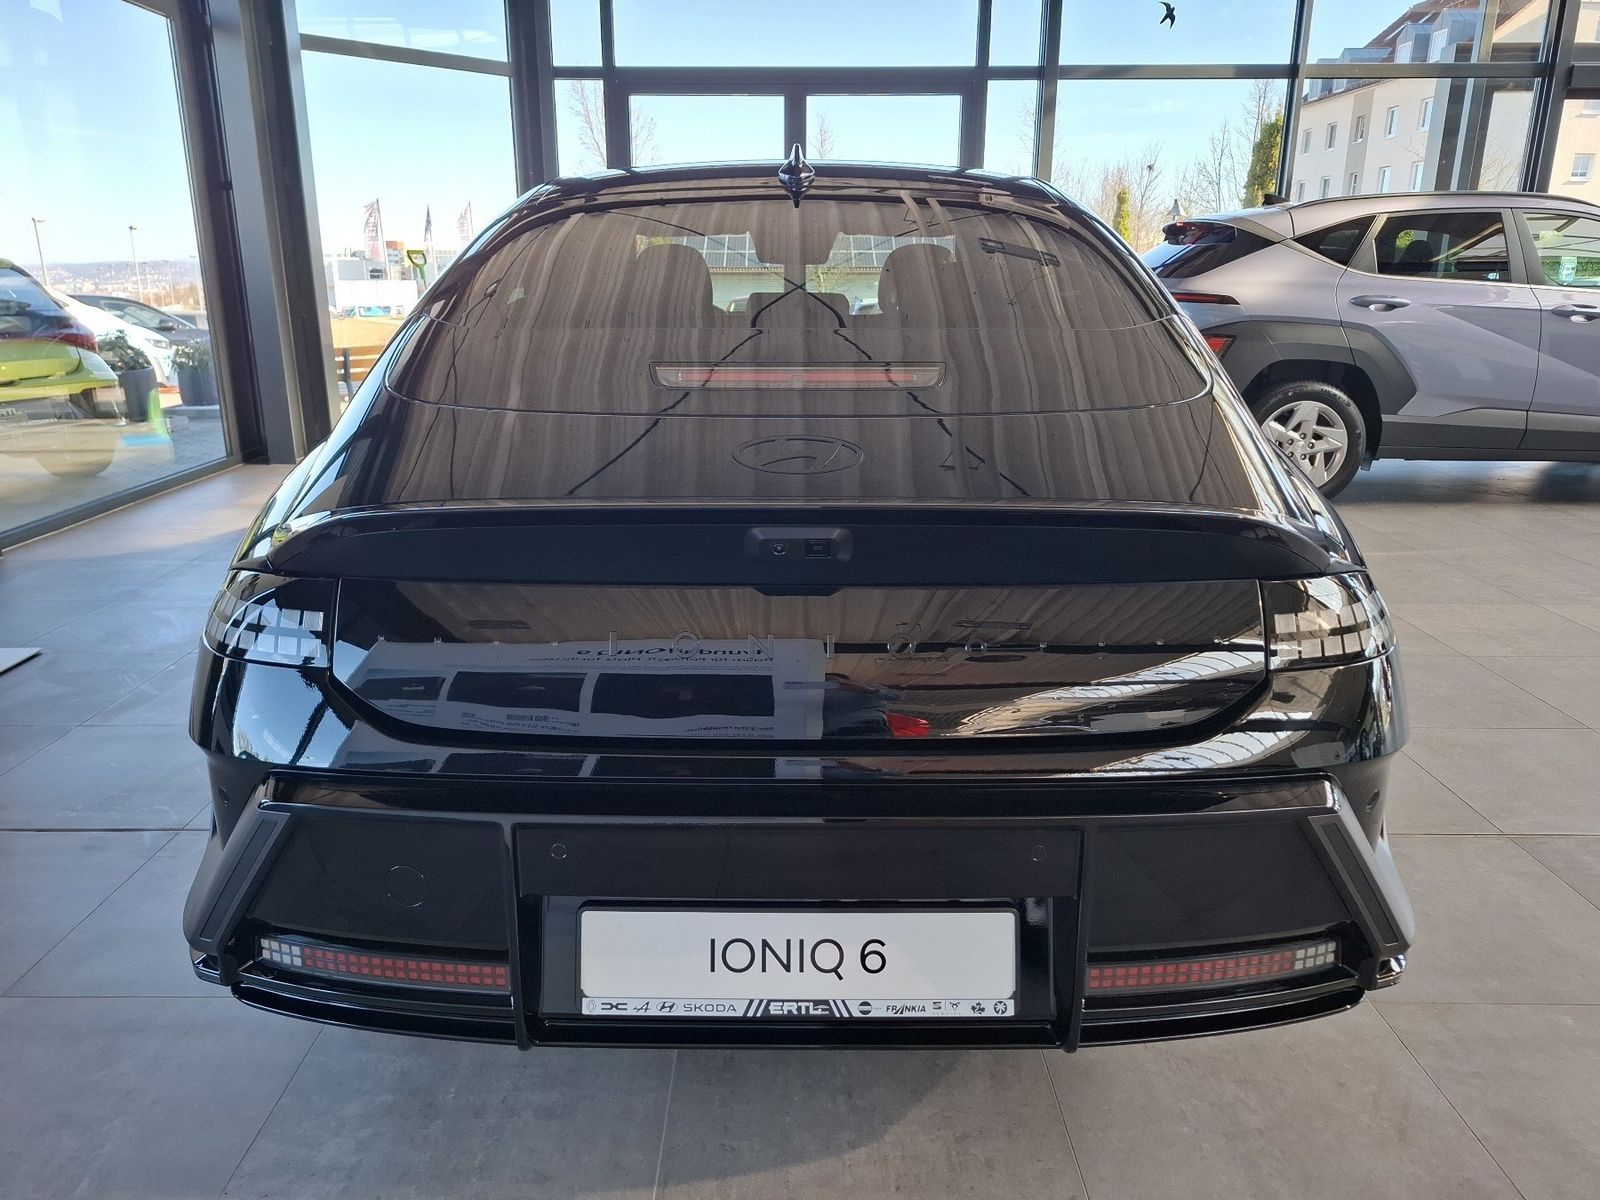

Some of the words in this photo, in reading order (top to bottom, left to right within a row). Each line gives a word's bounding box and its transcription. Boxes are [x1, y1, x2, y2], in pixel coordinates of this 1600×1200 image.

[710, 937, 844, 981] IONIQ
[859, 938, 887, 974] 6
[768, 1001, 830, 1015] ERTL
[886, 1003, 927, 1015] FRANKIA
